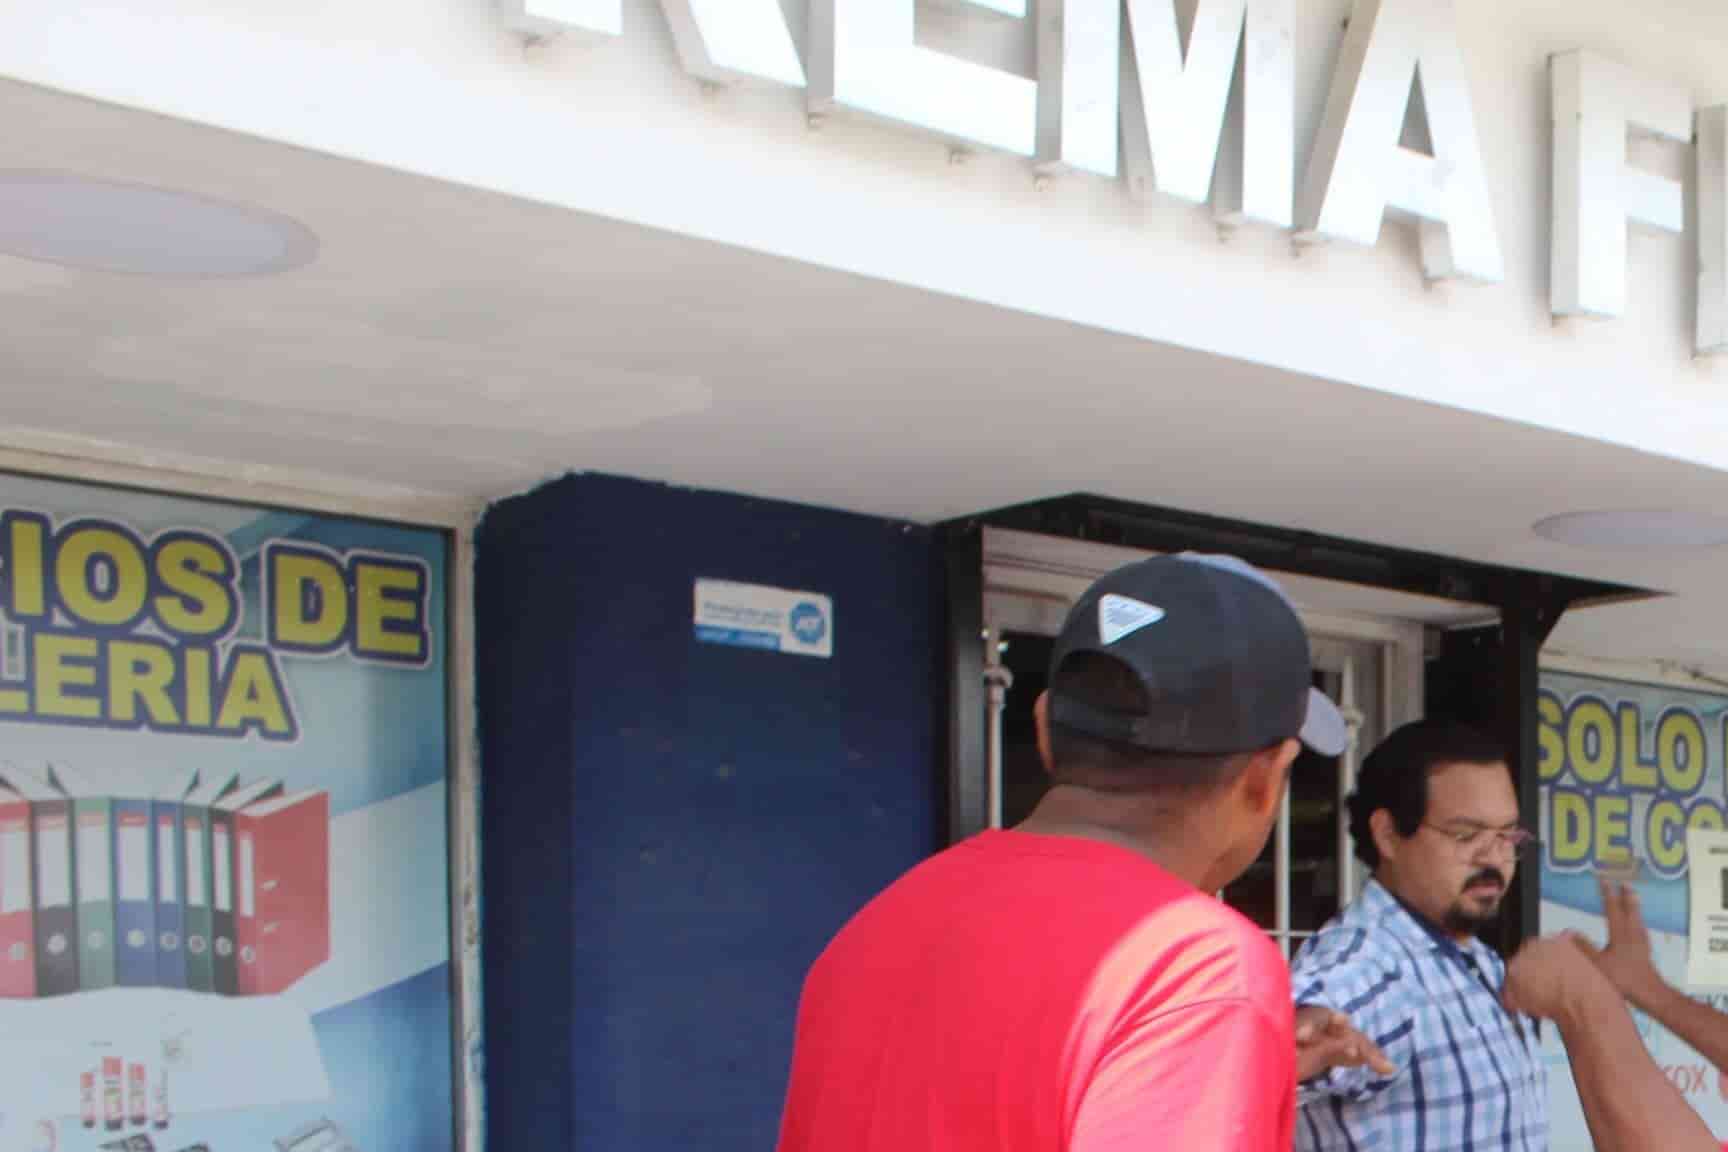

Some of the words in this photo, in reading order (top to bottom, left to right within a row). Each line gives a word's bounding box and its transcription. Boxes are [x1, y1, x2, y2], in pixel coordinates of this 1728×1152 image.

[520, 0, 1504, 282] EMA
[267, 543, 429, 663] DE
[1537, 688, 1707, 797] SOLO
[1550, 790, 1634, 869] DE
